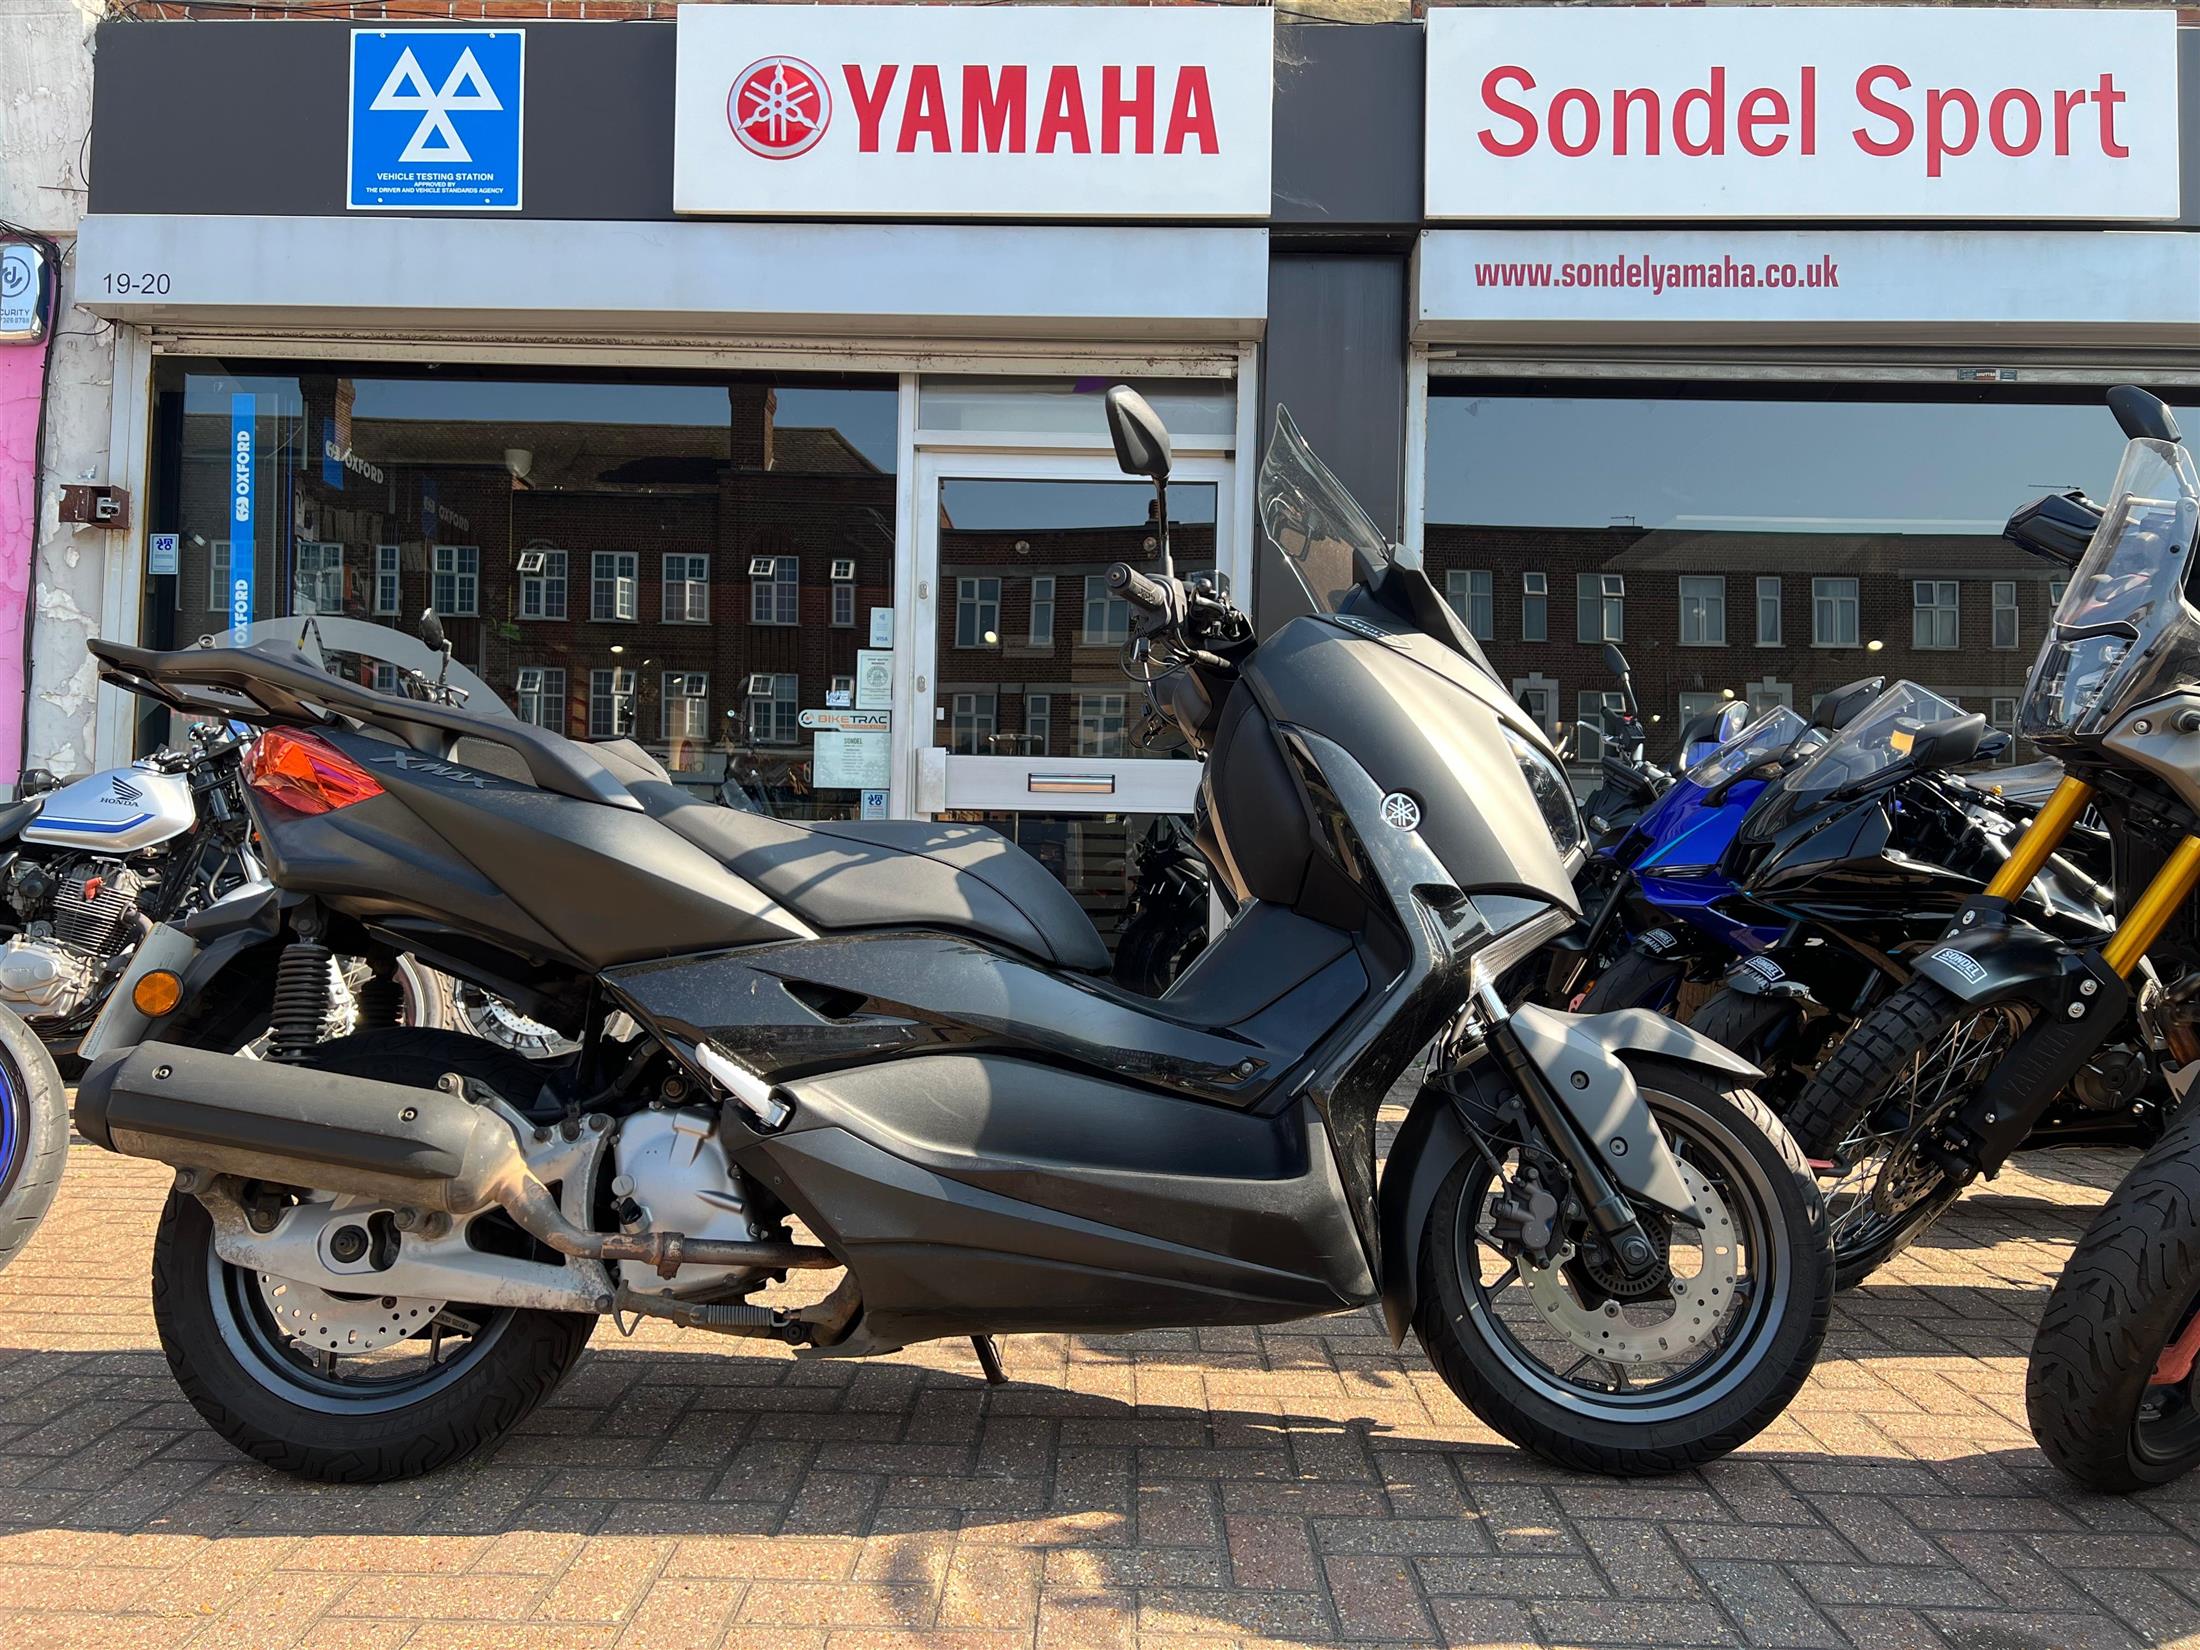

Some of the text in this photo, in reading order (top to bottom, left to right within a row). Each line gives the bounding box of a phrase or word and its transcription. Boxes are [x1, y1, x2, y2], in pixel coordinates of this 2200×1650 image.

[842, 64, 1219, 155] YAMAHA
[1478, 64, 2129, 177] Sondel Sport
[377, 173, 494, 181] VEHICLE TESTING STATION
[103, 273, 171, 295] 19-20
[1475, 254, 1838, 296] www.sondelyamaha.co.uk
[236, 430, 250, 496] OXFORD
[345, 451, 384, 485] OXFORD
[234, 578, 249, 646] OXFORD
[818, 715, 888, 724] BIKETRAC
[100, 797, 139, 807] HONDA
[1751, 956, 1780, 976] SONDEL
[1942, 950, 1980, 977] SONDEL
